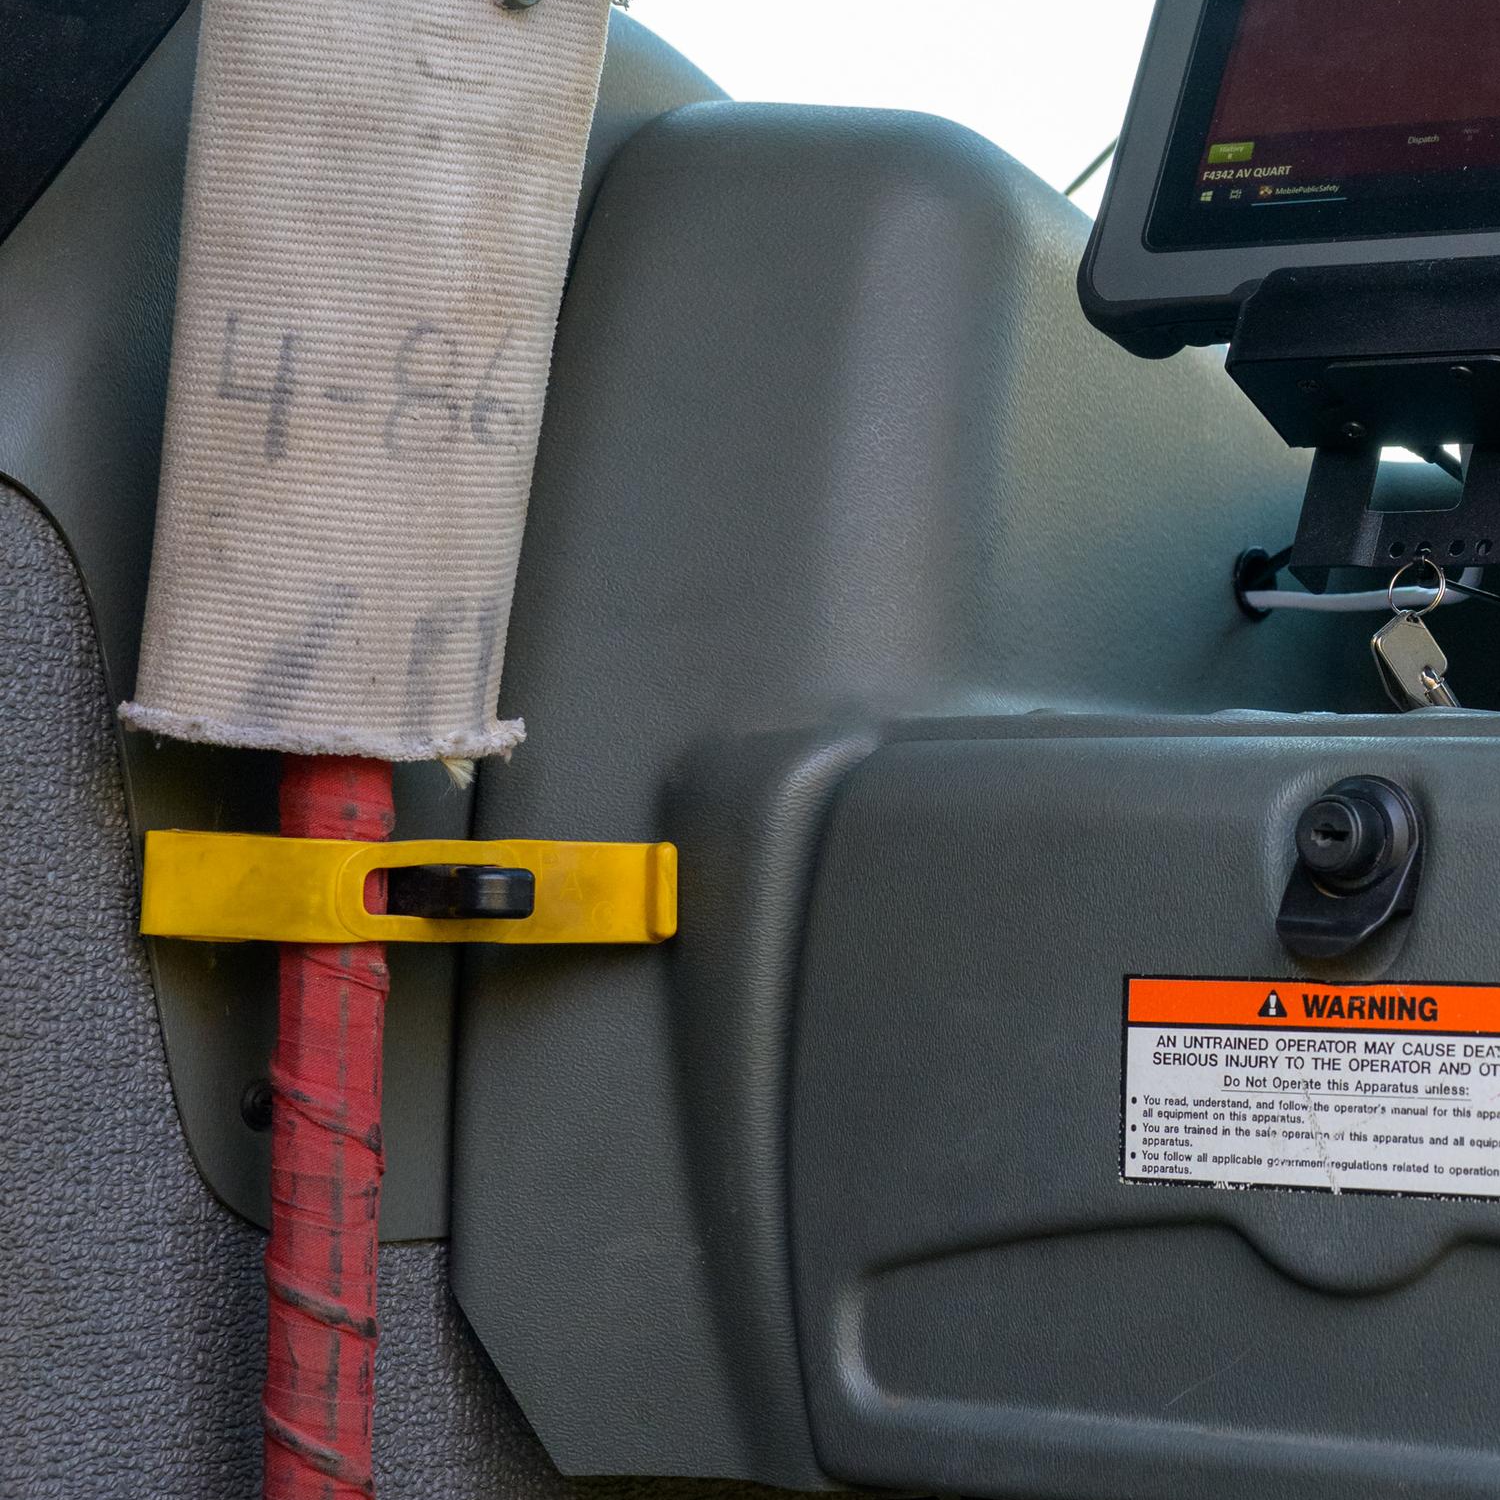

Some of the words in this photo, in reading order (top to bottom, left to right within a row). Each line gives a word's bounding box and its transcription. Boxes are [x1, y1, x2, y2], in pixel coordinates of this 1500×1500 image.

[1407, 133, 1440, 146] Dispatch
[1202, 169, 1235, 181] F4342
[1235, 167, 1253, 179] AV
[1253, 165, 1293, 178] QUART
[1275, 184, 1341, 196] MobilePublicSafety
[1301, 994, 1439, 1022] WARNING
[1156, 1035, 1177, 1048] AN
[1183, 1036, 1269, 1051] UNTRAINED
[1275, 1038, 1357, 1054] OPERATOR
[1364, 1041, 1395, 1055] MAY
[1402, 1042, 1456, 1057] CAUSE
[1152, 1052, 1219, 1067] SERIOUS
[1225, 1054, 1279, 1069] INJURY
[1285, 1056, 1305, 1070] TO
[1312, 1057, 1342, 1071] THE
[1348, 1058, 1431, 1074] OPERATOR
[1438, 1061, 1471, 1075] AND
[1223, 1075, 1241, 1087] Do
[1246, 1076, 1267, 1088] Not
[1272, 1077, 1322, 1092] Operate
[1327, 1078, 1350, 1091] this
[1355, 1080, 1419, 1095] Apparatus
[1425, 1082, 1470, 1096] unless:
[1142, 1108, 1153, 1118] all
[1157, 1109, 1209, 1121] equipment
[1212, 1113, 1225, 1121] on
[1229, 1111, 1247, 1122] this
[1251, 1113, 1305, 1125] apparatus.
[1143, 1095, 1161, 1106] You
[1164, 1096, 1189, 1108] read,
[1193, 1097, 1252, 1110] understand,
[1256, 1099, 1274, 1110] and
[1279, 1100, 1308, 1111] follow
[1313, 1101, 1330, 1112] the
[1334, 1103, 1386, 1116] operator's
[1391, 1105, 1428, 1117] manual
[1433, 1106, 1448, 1117] for
[1452, 1107, 1471, 1118] this
[1142, 1122, 1160, 1133] You
[1164, 1125, 1180, 1134] are
[1184, 1124, 1218, 1135] trained
[1222, 1126, 1231, 1136] in
[1235, 1127, 1251, 1137] the
[1255, 1127, 1277, 1138] safe
[1333, 1131, 1344, 1141] of
[1350, 1131, 1368, 1142] this
[1372, 1133, 1424, 1146] apparatus
[1429, 1136, 1449, 1146] and
[1453, 1136, 1465, 1147] all
[1142, 1137, 1193, 1148] apparatus.
[1141, 1164, 1193, 1175] apparatus.
[1142, 1150, 1160, 1161] You
[1163, 1151, 1192, 1162] follow
[1196, 1153, 1208, 1163] all
[1211, 1153, 1263, 1166] applicable
[1330, 1160, 1388, 1173] regulations
[1392, 1162, 1429, 1174] related
[1433, 1164, 1444, 1174] to
[1449, 1165, 1500, 1178] operation
